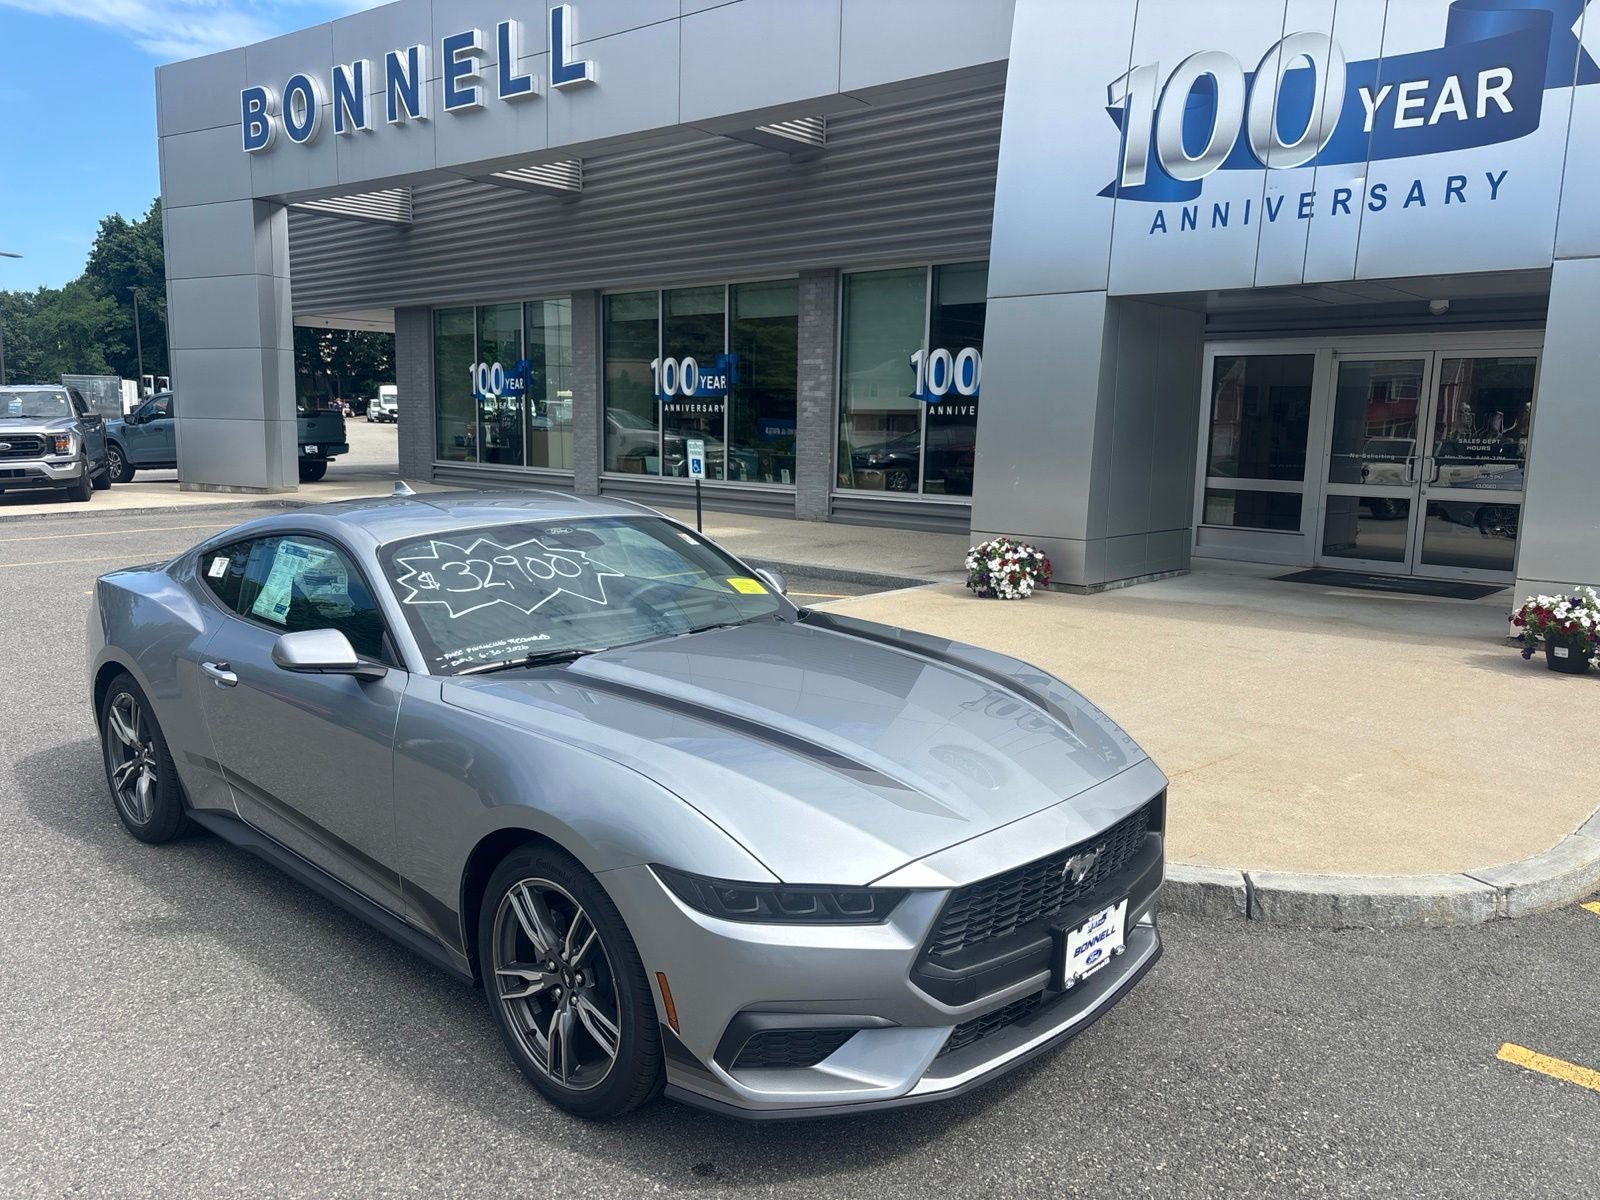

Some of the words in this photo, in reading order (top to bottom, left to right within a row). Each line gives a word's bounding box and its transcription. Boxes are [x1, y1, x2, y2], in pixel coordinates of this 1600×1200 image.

[241, 4, 594, 152] BONNELL
[1107, 31, 1346, 188] 100
[1358, 66, 1514, 133] YEAR
[1149, 170, 1509, 235] ANNIVERSARY
[469, 362, 504, 395] 100
[651, 356, 699, 396] 100
[700, 375, 727, 389] YEAR
[910, 347, 982, 396] 100
[664, 404, 725, 412] ANNIVERSARY
[929, 405, 976, 415] ANNIVE
[1073, 924, 1116, 958] BONNELL
